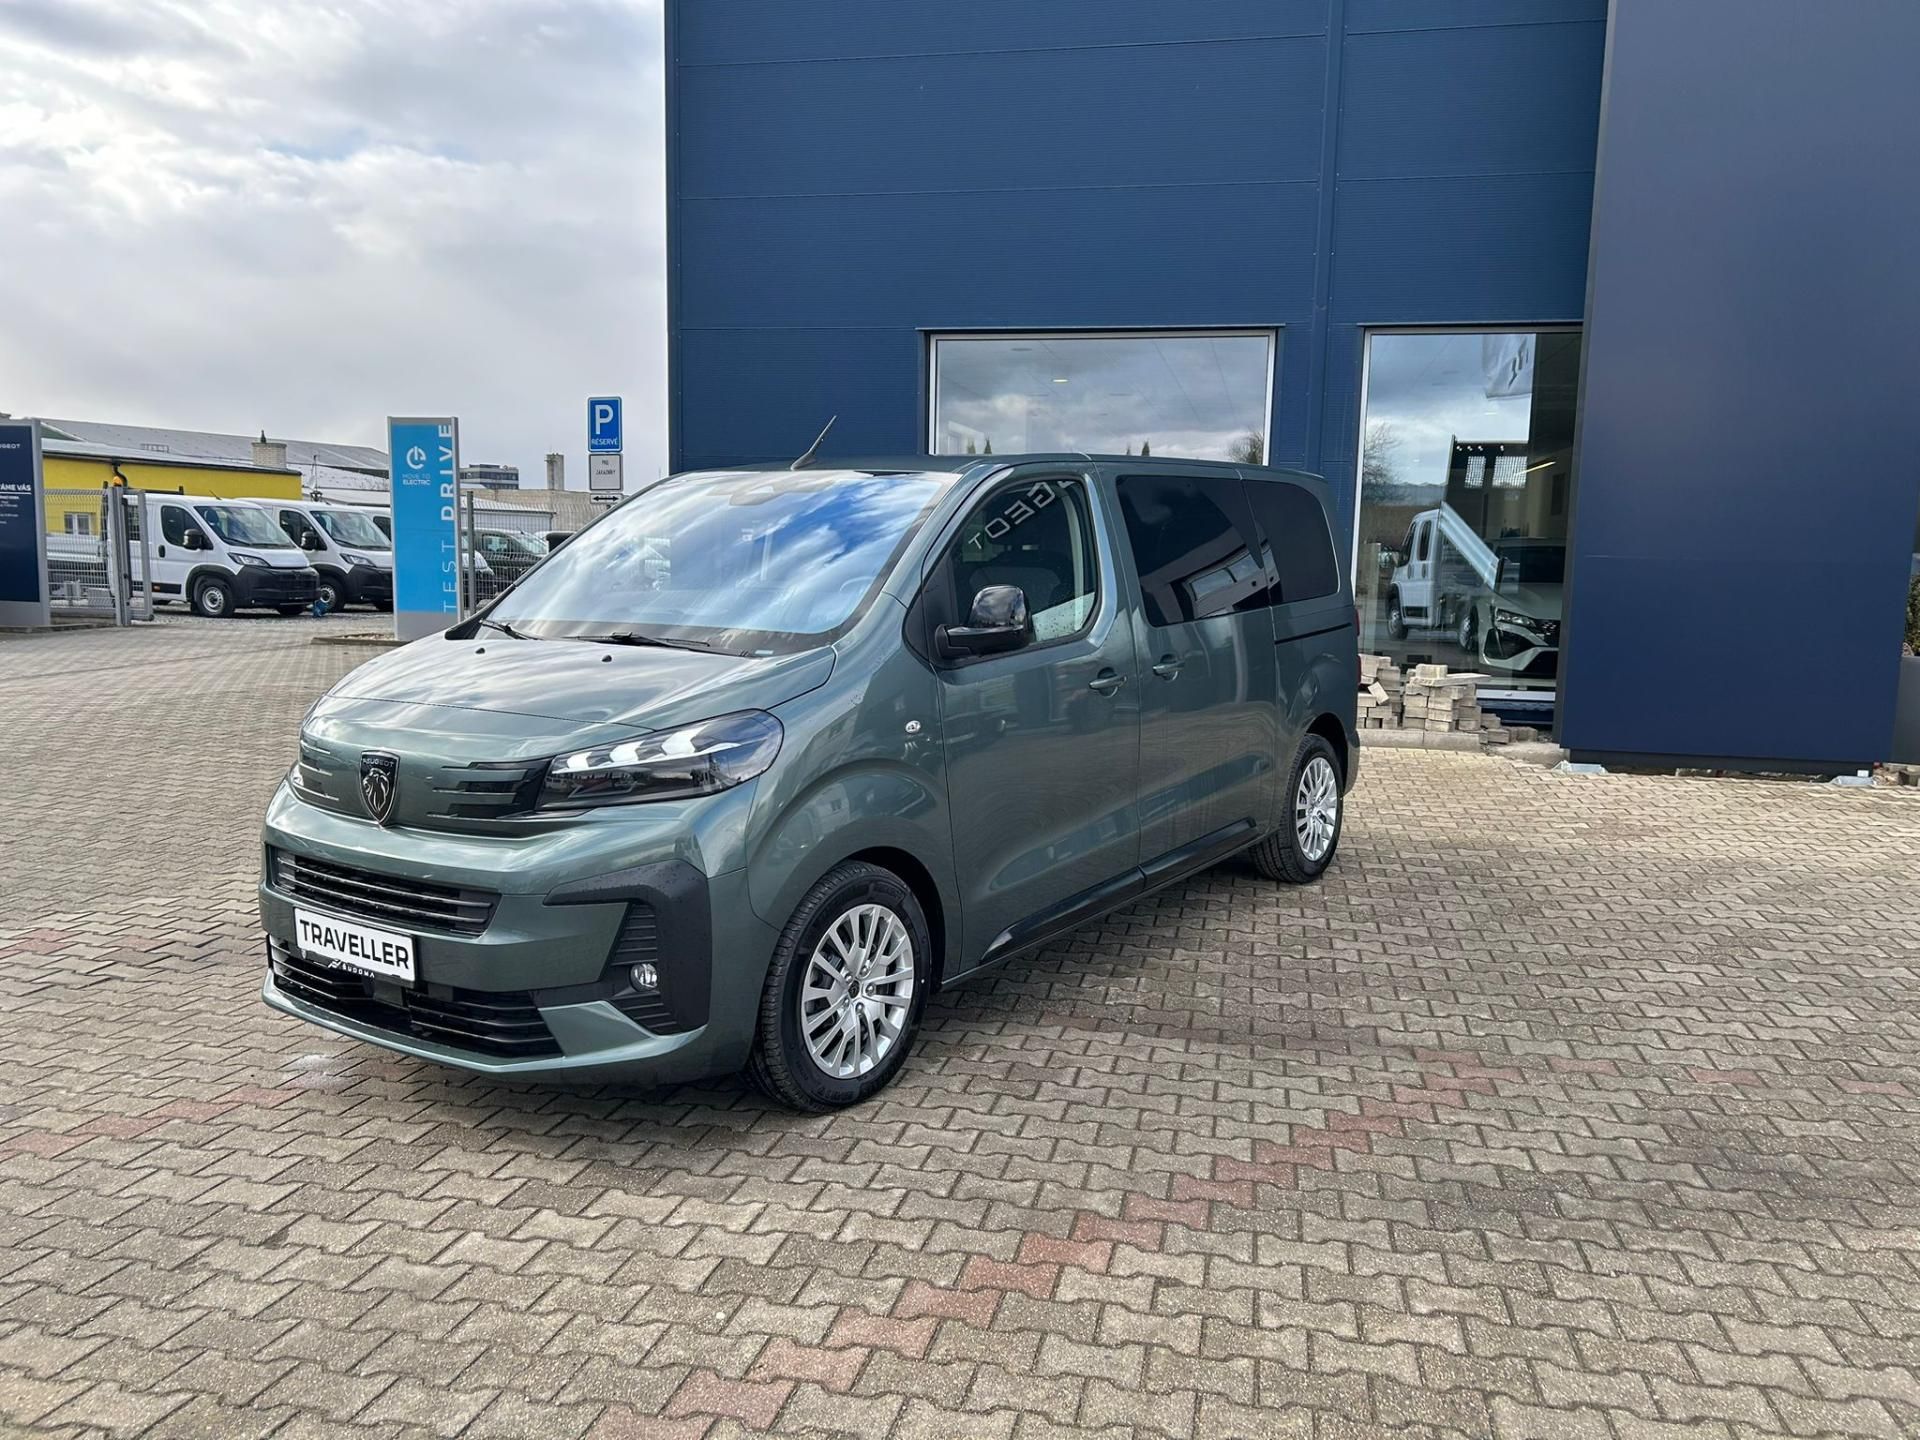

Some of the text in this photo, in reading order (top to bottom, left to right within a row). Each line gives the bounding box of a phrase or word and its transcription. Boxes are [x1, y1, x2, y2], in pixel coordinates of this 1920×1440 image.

[594, 404, 614, 435] P
[438, 424, 457, 613] TEST DRIVE
[299, 918, 409, 970] TRAVELLER
